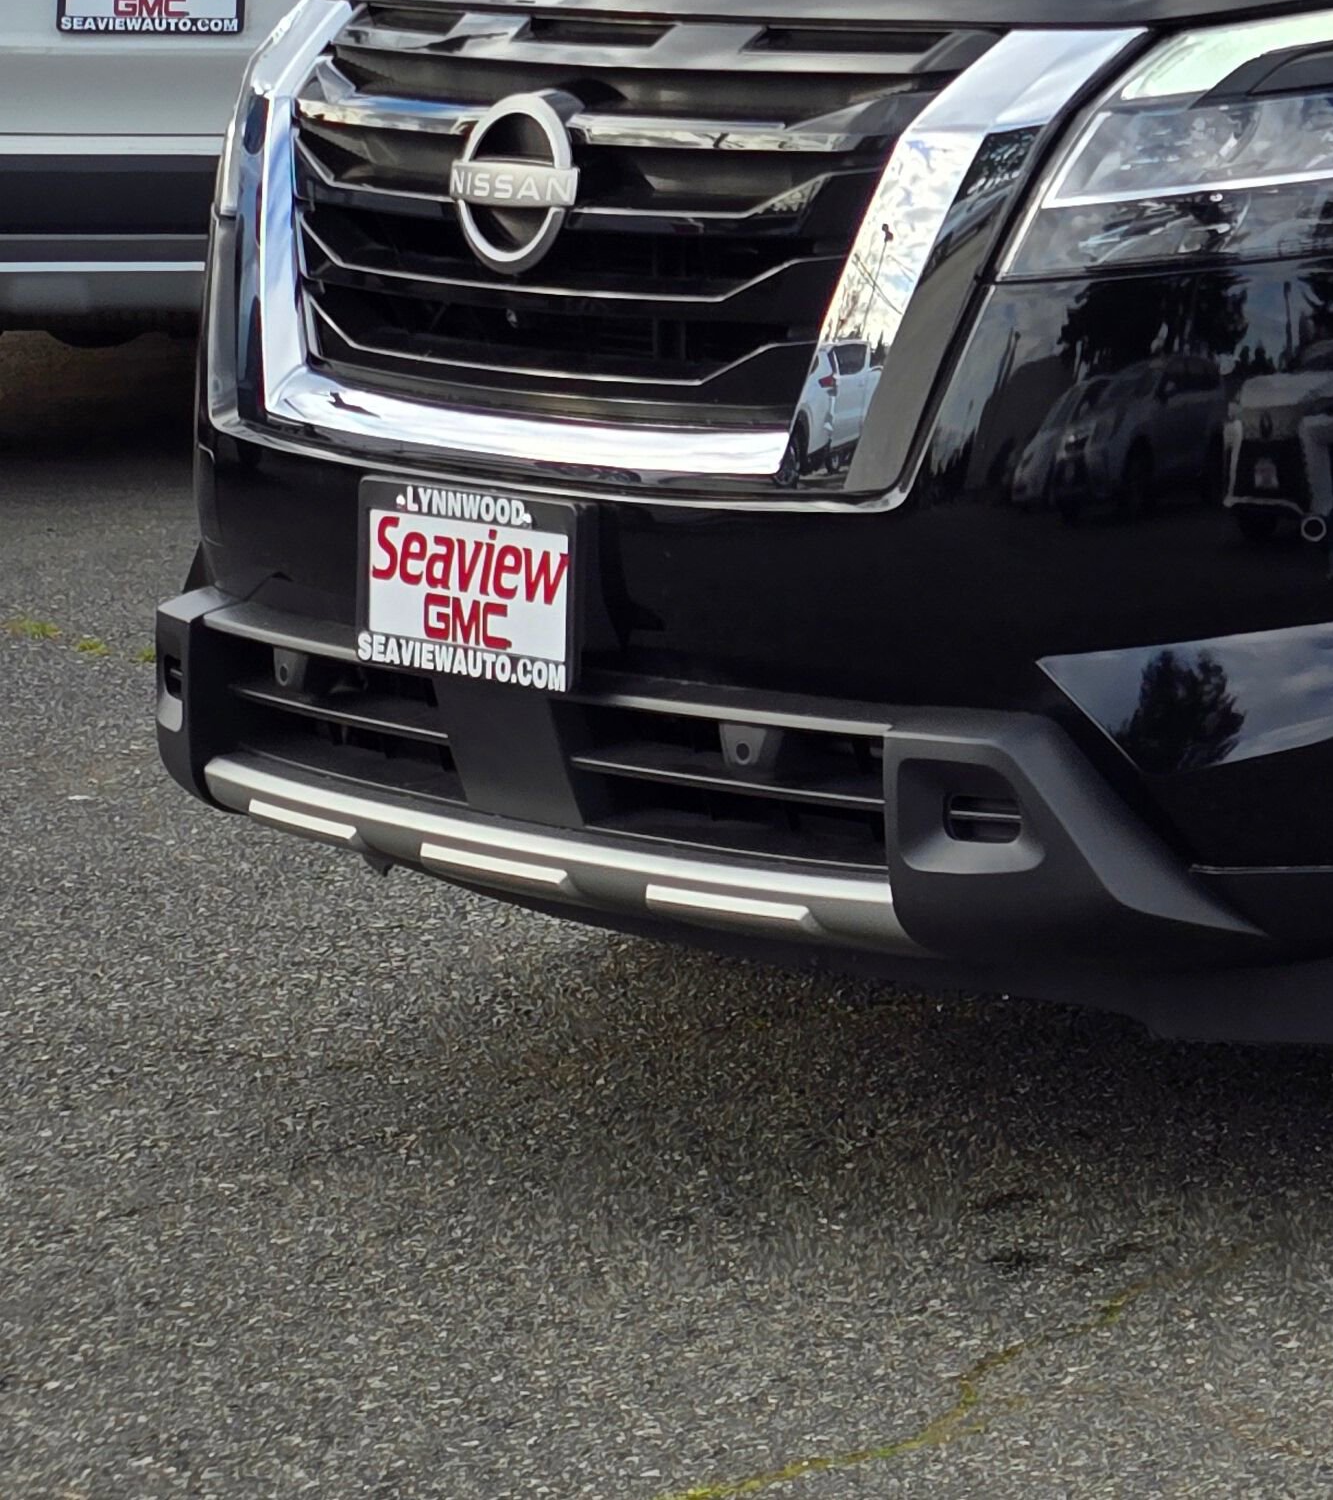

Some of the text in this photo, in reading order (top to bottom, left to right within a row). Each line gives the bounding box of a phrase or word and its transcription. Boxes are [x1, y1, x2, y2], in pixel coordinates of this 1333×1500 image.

[60, 17, 238, 32] SEAVIEWAUTO.COM
[452, 168, 573, 204] NISSAN
[406, 485, 525, 526] LYNNWOOD
[371, 515, 570, 605] Seaview
[423, 592, 512, 650] GMC
[357, 631, 567, 692] SEAVIEWAUTO.COM
